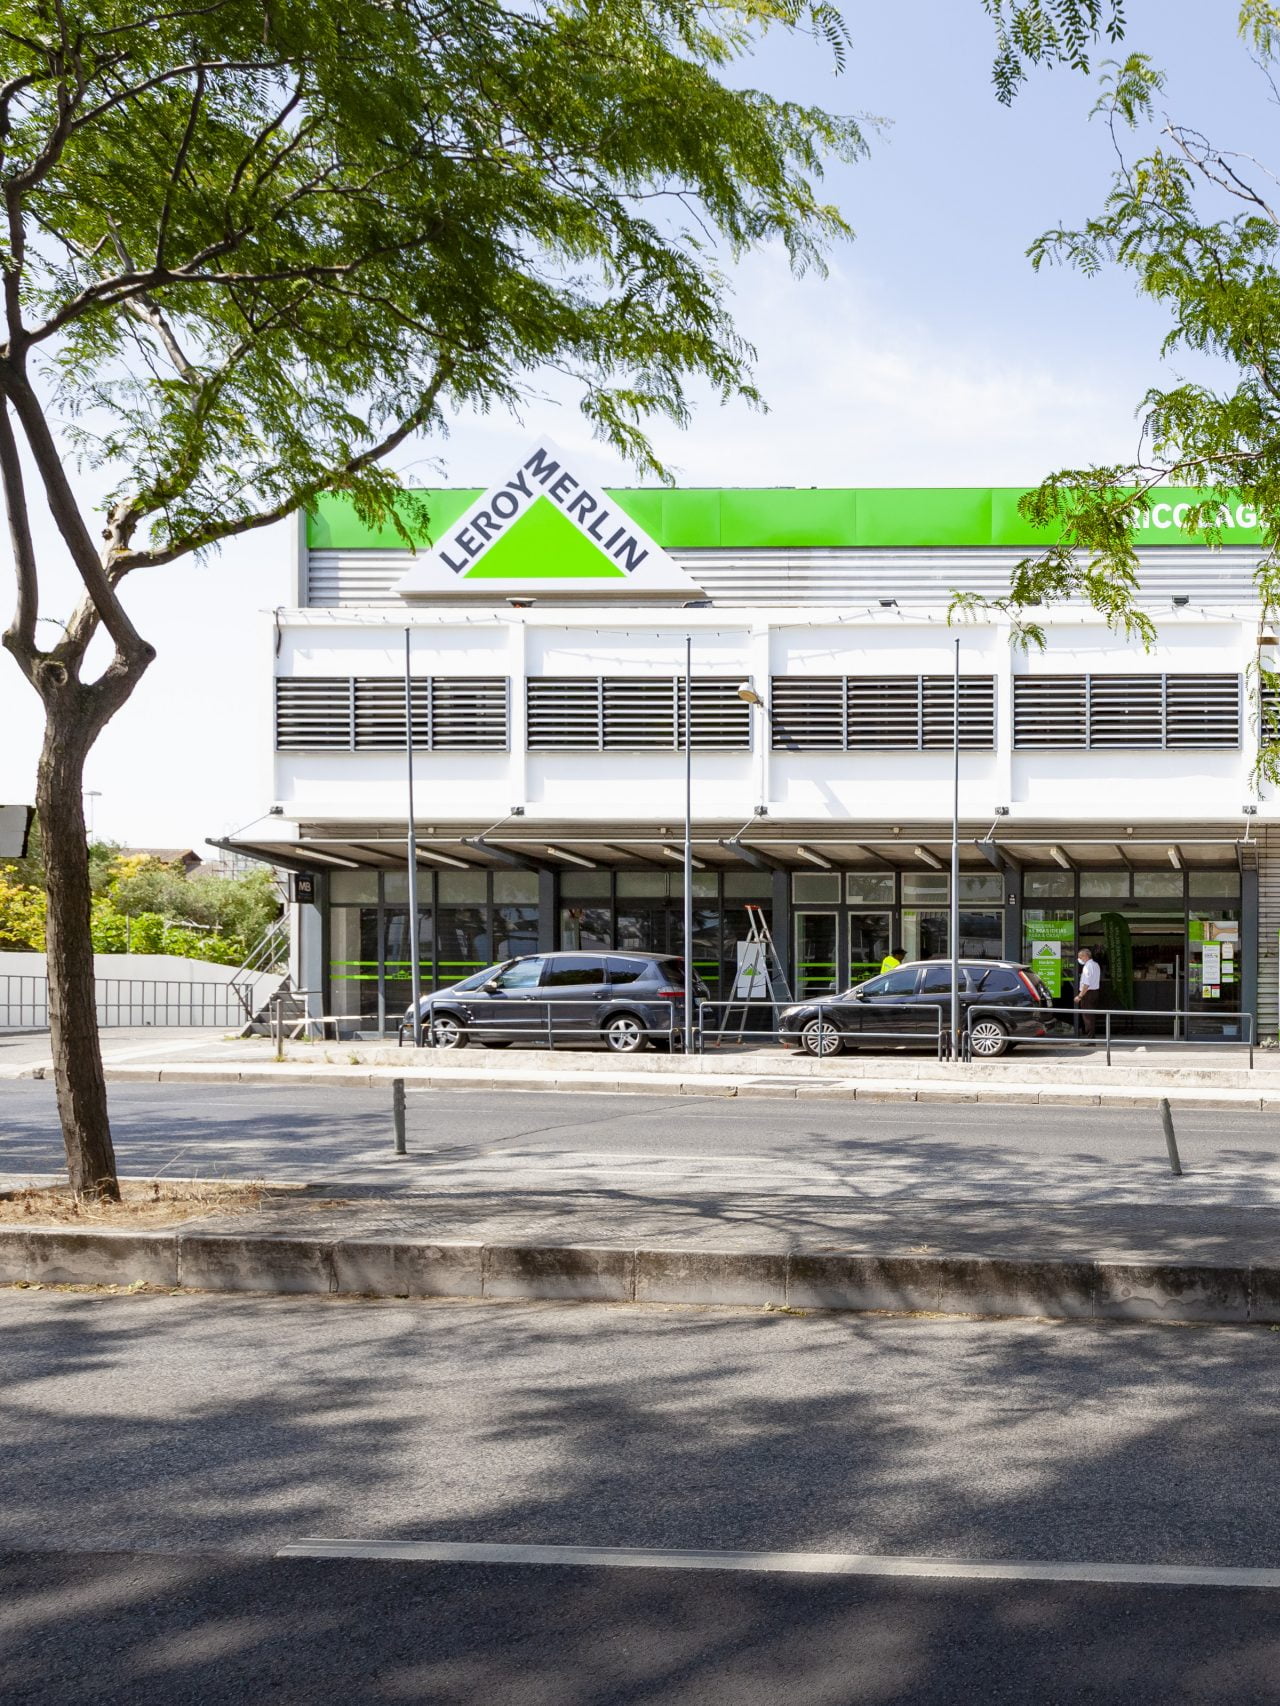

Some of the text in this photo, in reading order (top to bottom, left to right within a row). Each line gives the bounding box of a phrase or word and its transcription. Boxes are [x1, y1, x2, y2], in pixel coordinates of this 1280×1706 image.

[438, 447, 649, 575] LEROY MERLIN
[298, 881, 311, 892] MB
